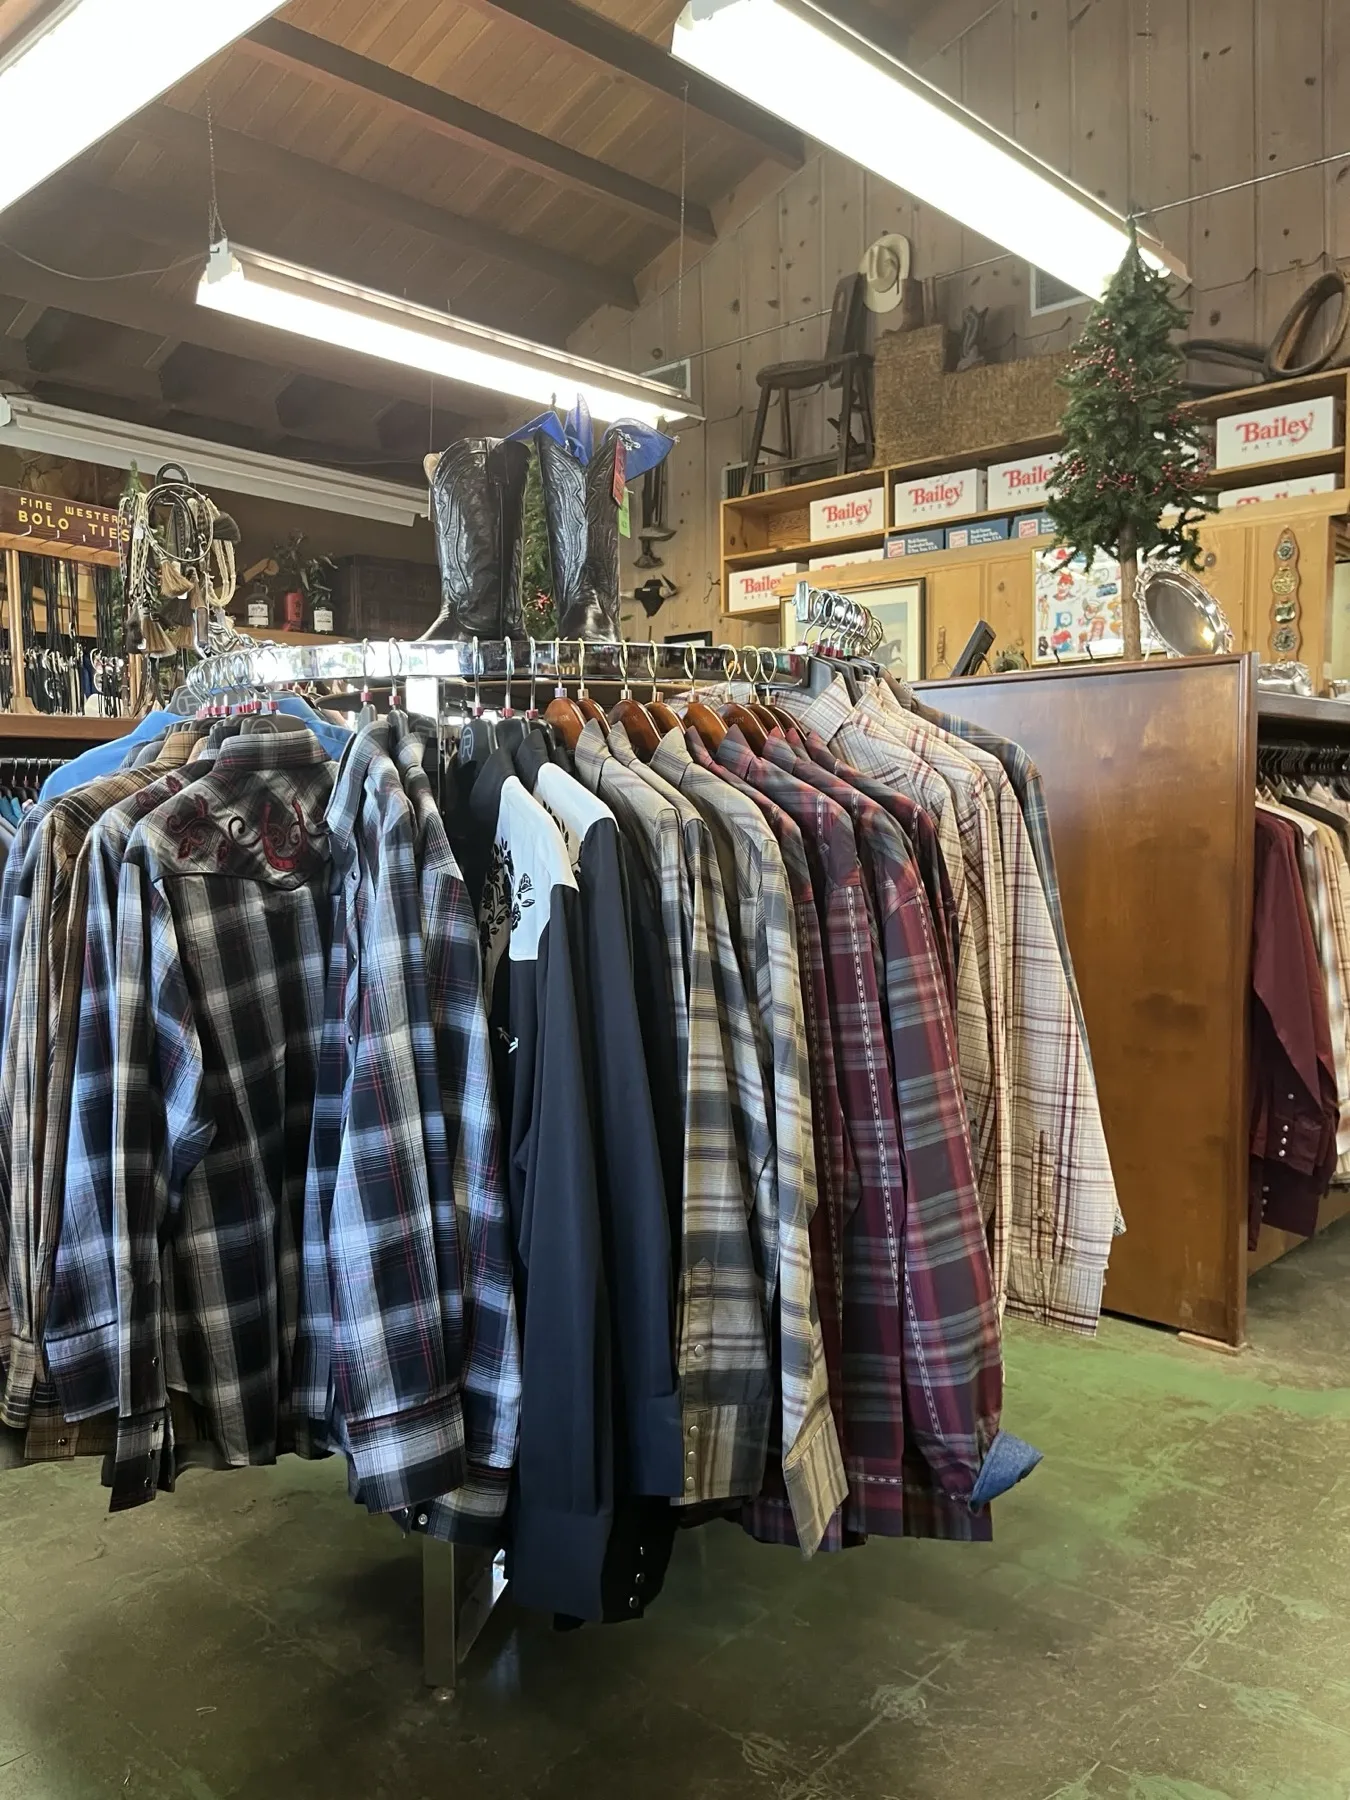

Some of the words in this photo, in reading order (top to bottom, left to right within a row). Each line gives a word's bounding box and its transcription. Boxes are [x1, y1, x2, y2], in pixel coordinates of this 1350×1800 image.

[1235, 411, 1314, 444] Bailey
[1002, 464, 1053, 488] Baile
[908, 480, 964, 507] Bailey
[821, 498, 873, 524] Bailey
[18, 509, 69, 531] BOLO
[87, 523, 131, 542] TIES
